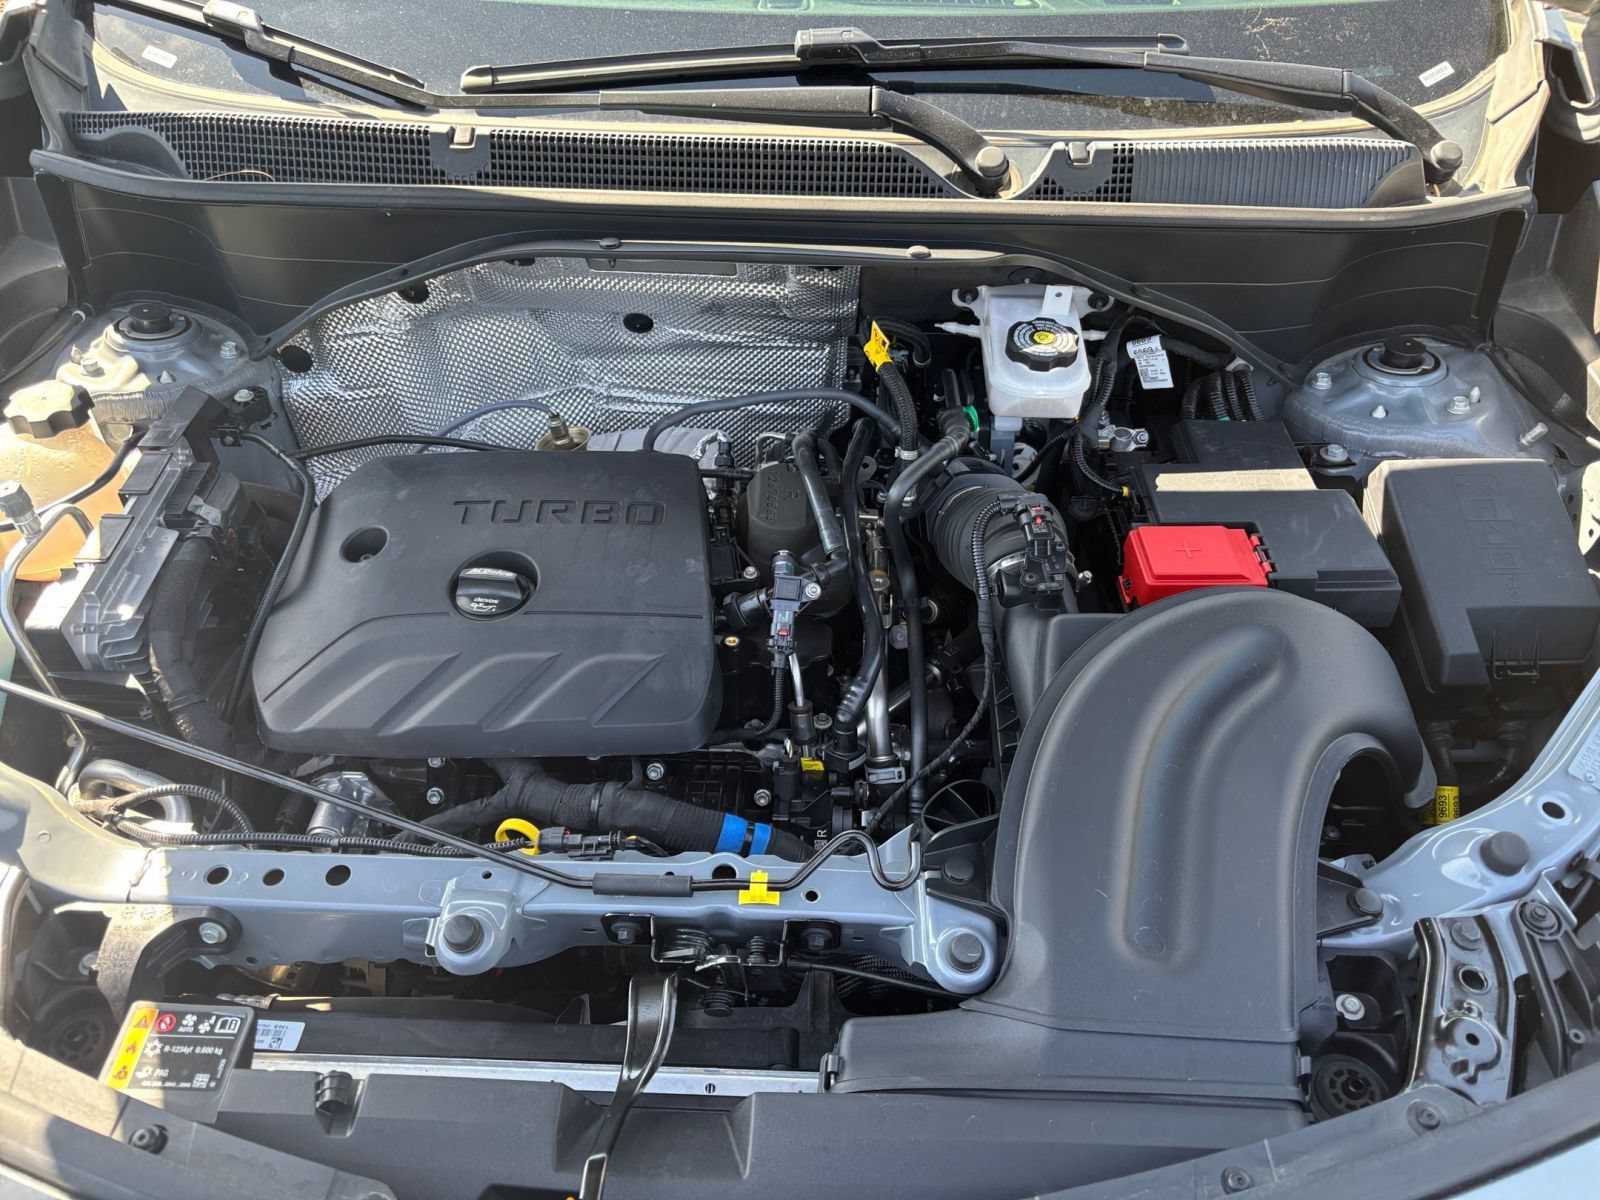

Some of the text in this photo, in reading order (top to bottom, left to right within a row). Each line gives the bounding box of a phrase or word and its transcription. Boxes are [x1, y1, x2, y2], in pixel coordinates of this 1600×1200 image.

[453, 499, 666, 525] TURBO
[1438, 795, 1447, 818] 9693
[214, 1046, 224, 1056] kg
